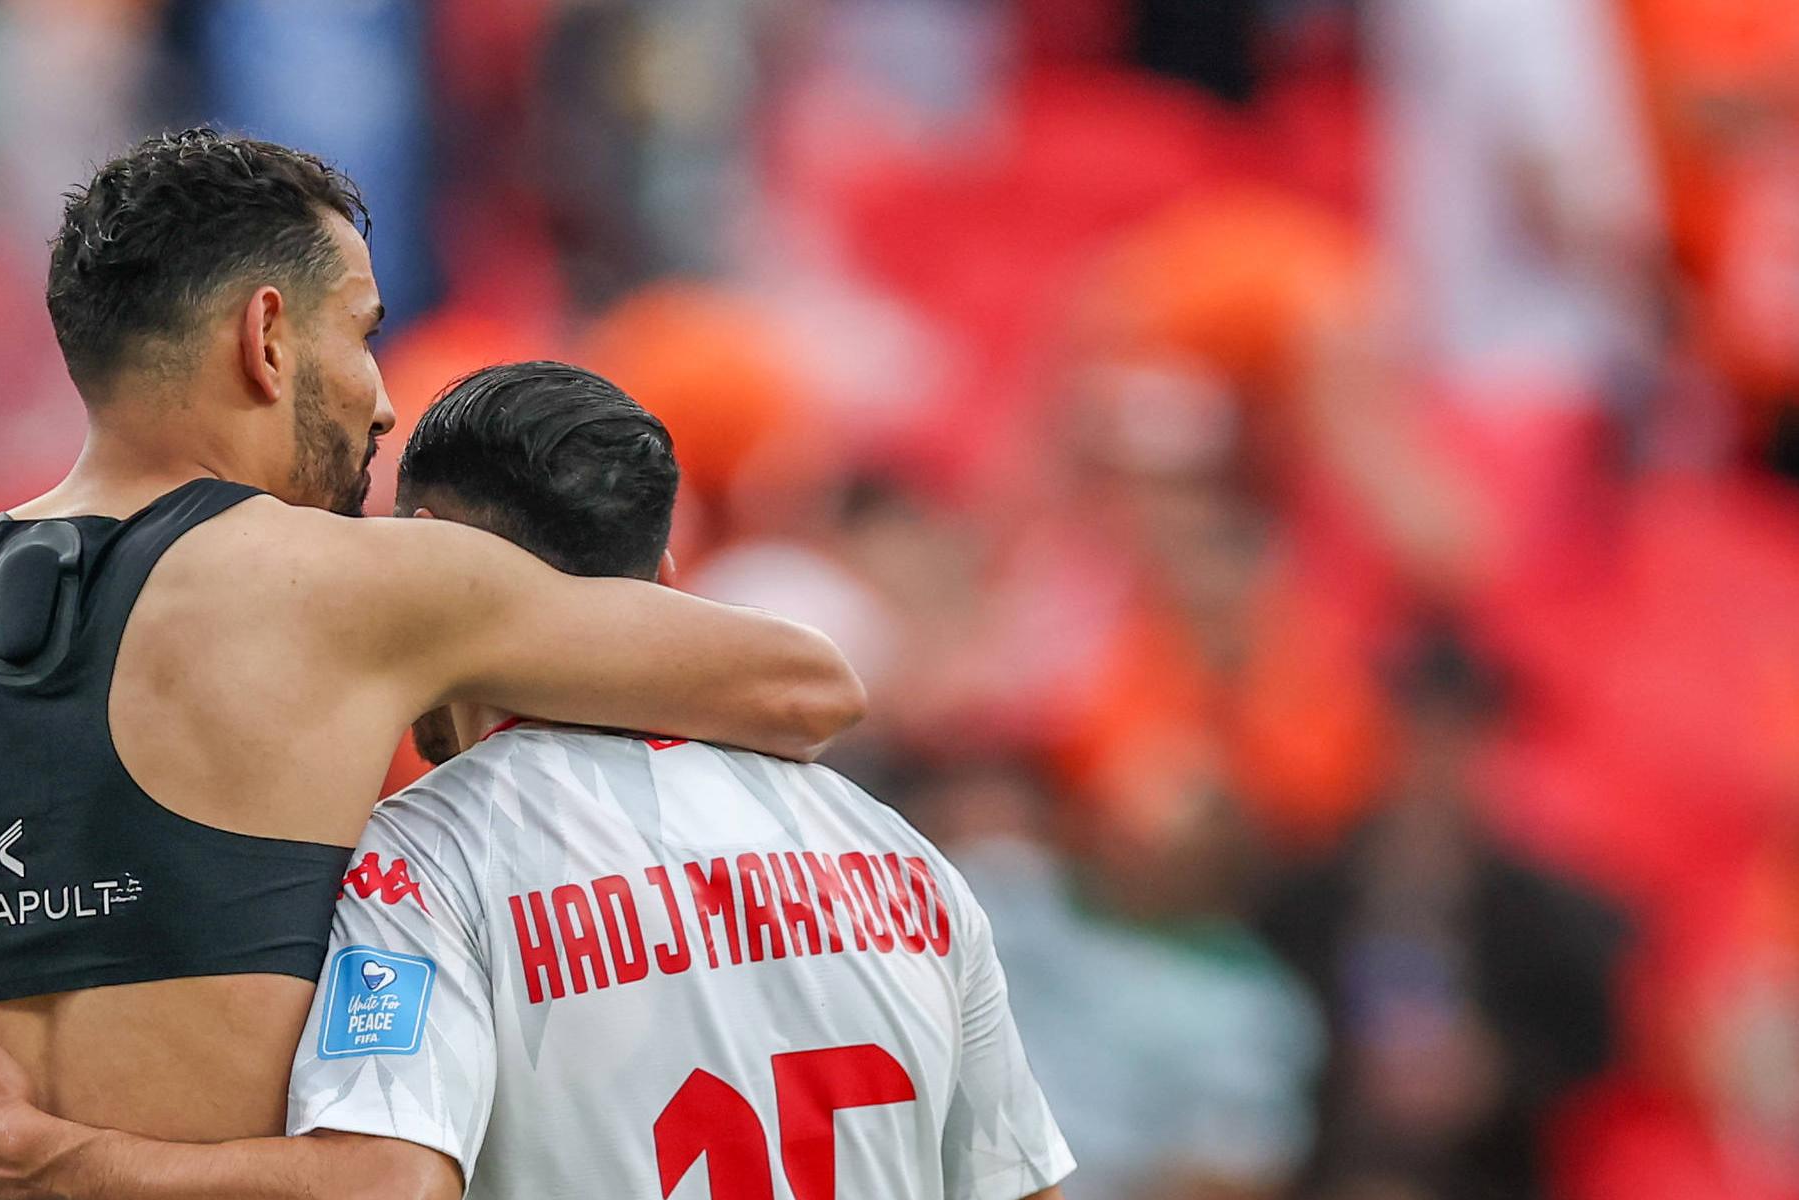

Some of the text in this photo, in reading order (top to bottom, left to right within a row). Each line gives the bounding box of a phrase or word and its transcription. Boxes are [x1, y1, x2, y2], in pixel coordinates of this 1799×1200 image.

[508, 851, 950, 1004] HADJ MAHMOUD
[347, 993, 401, 1015] Unite For
[347, 1012, 395, 1034] PEACE
[354, 1033, 379, 1045] FIFA
